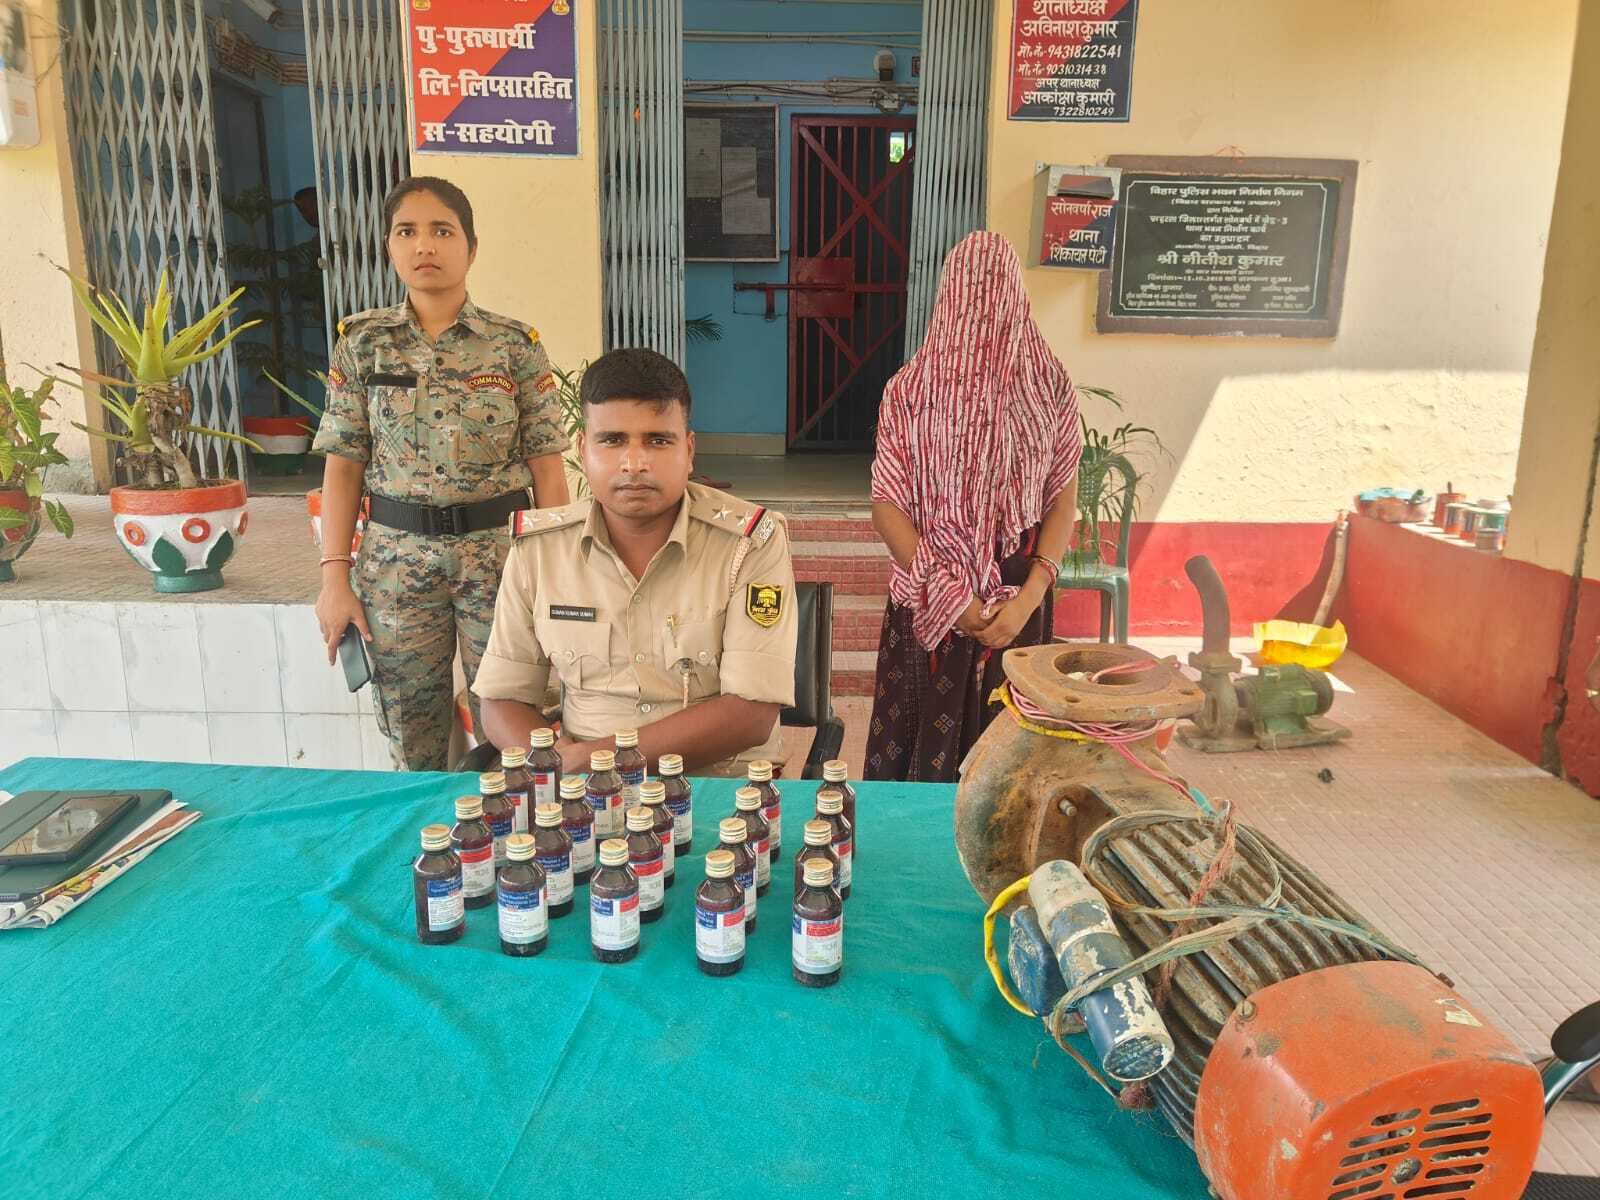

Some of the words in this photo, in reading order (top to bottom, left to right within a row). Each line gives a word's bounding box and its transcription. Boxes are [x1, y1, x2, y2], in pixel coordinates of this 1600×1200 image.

[1032, 0, 1108, 16] थानाध्यक्ष
[420, 119, 556, 145] स-सहयोगी
[1068, 229, 1100, 243] थाना
[1157, 250, 1178, 265] श्री
[1237, 254, 1286, 269] कुमार
[468, 376, 512, 390] COMMANDO
